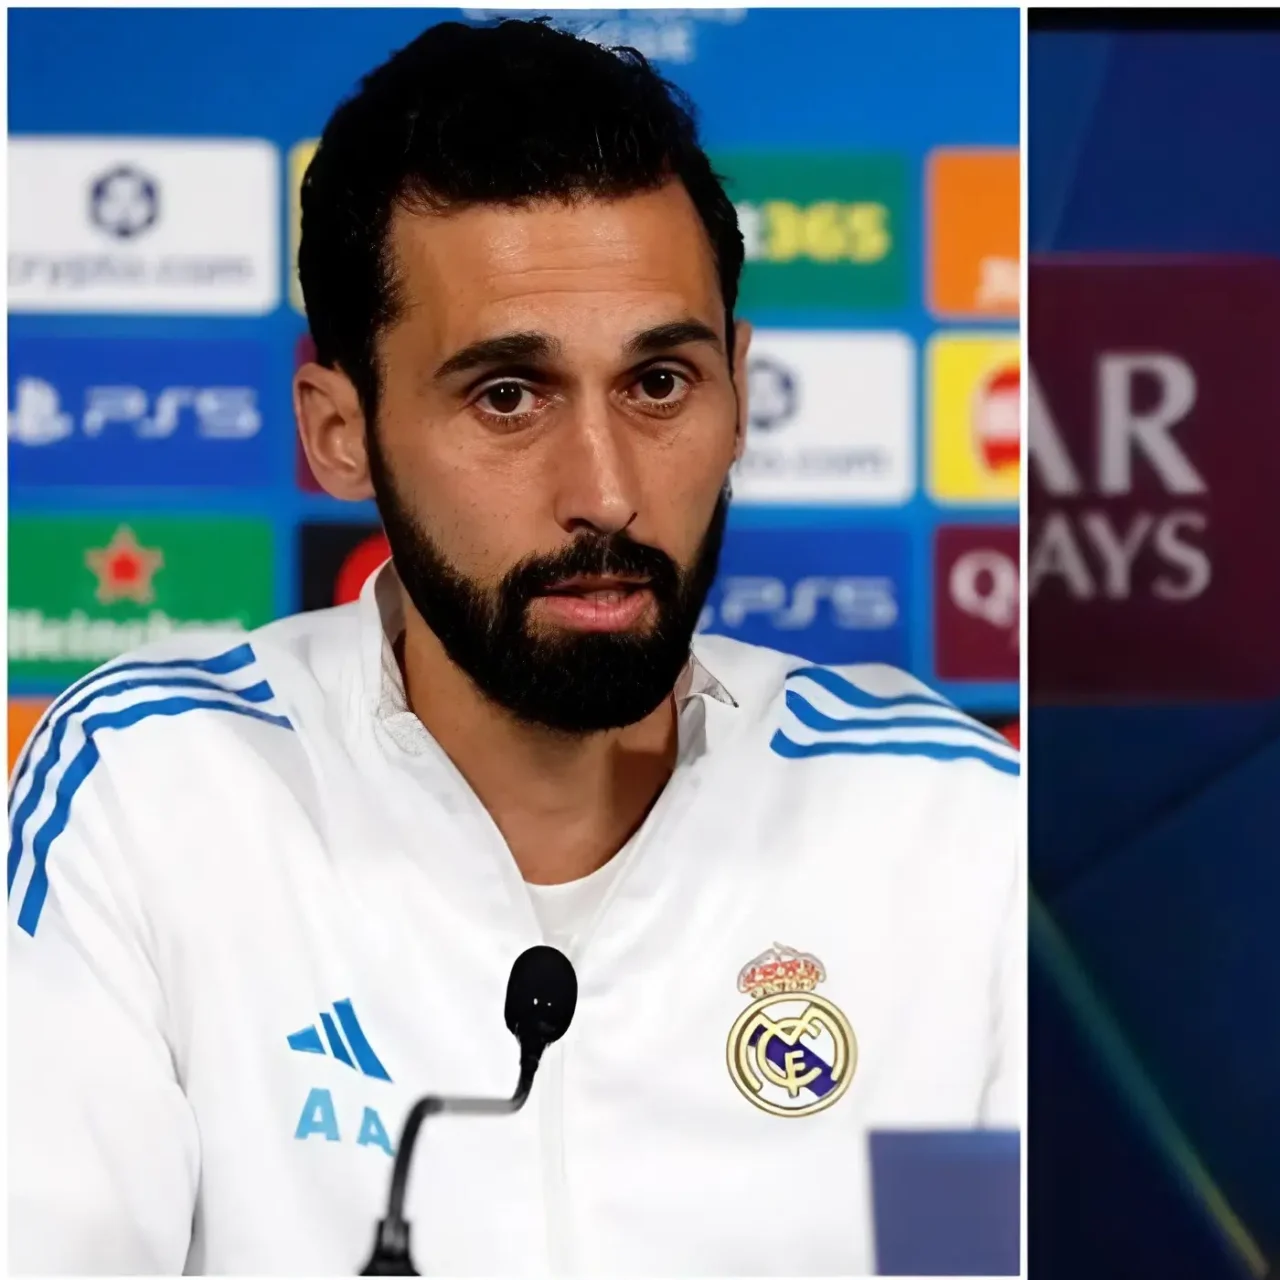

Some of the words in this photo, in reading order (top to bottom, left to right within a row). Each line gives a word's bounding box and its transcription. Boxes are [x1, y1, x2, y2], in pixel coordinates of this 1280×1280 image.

[82, 385, 262, 439] PS5
[1028, 510, 1212, 600] AYS
[720, 575, 898, 630] PS5
